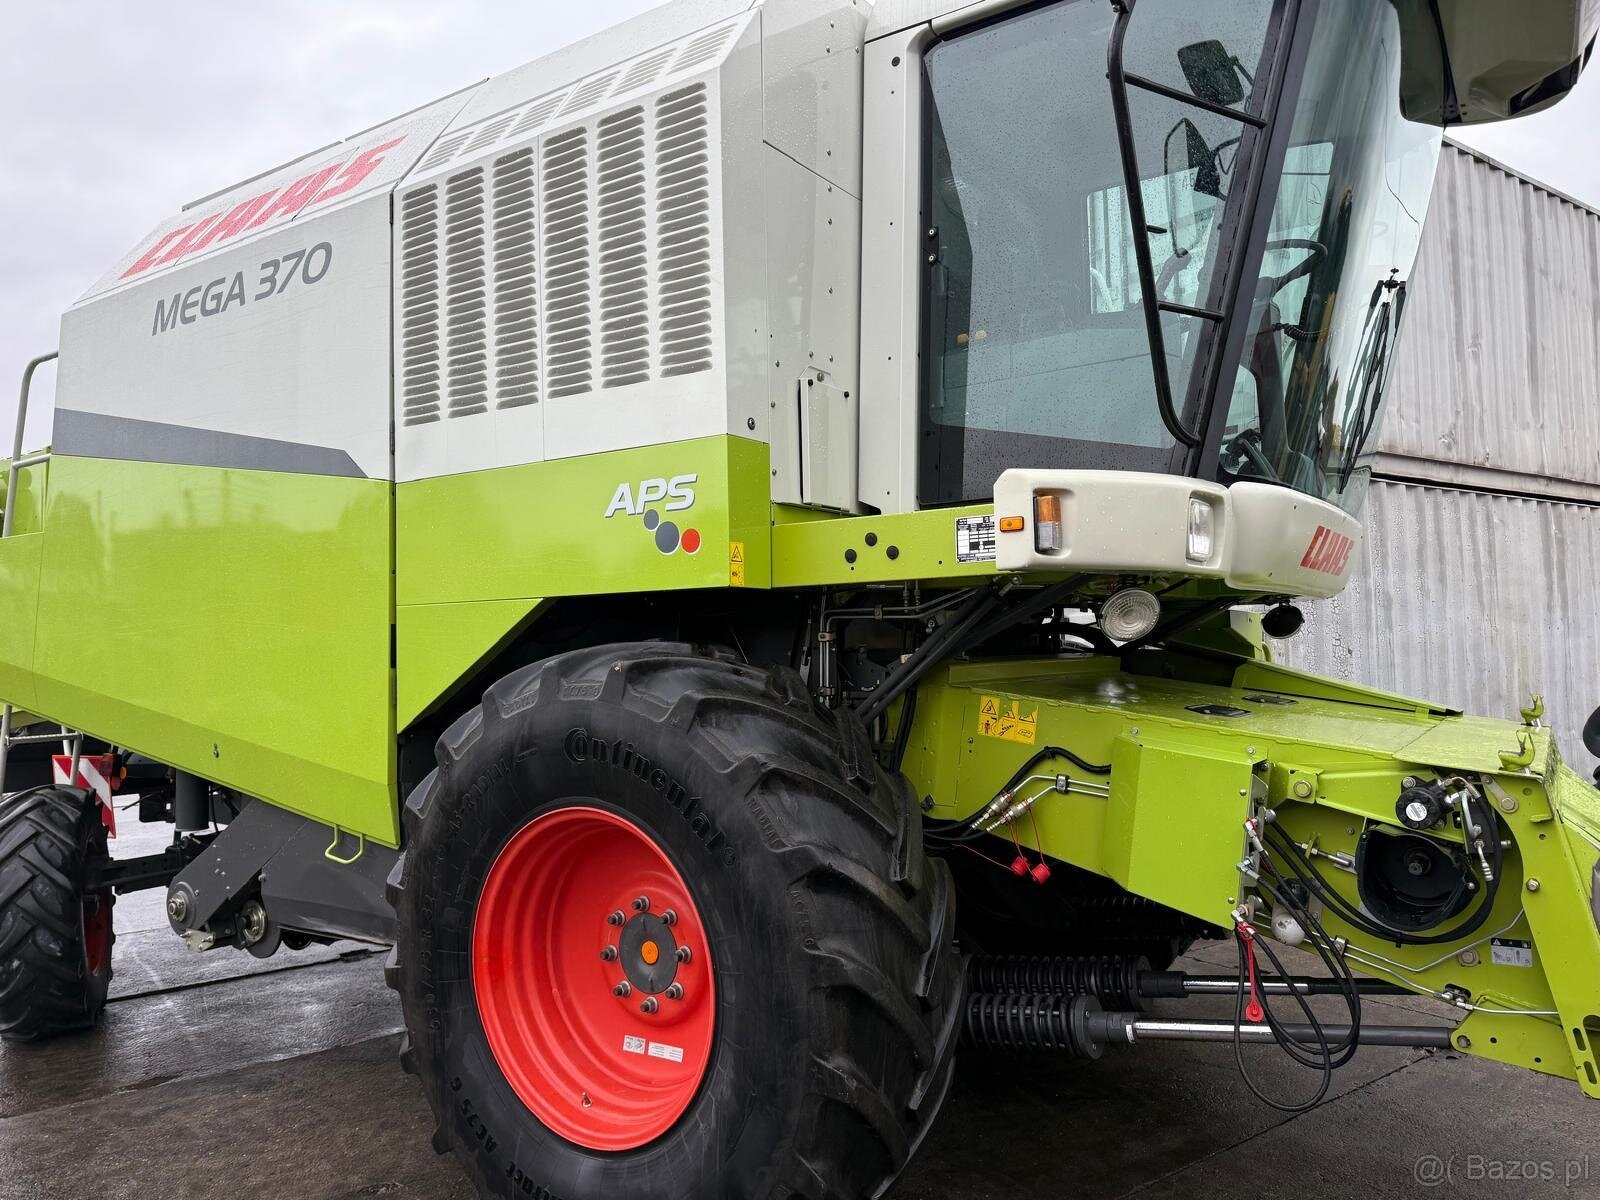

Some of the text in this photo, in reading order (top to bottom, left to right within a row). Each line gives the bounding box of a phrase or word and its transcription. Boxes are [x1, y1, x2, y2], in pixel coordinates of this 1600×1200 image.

[118, 135, 408, 280] CLAAS
[152, 241, 333, 337] MEGA 370
[604, 473, 698, 518] APS
[1300, 525, 1354, 577] CLAAS
